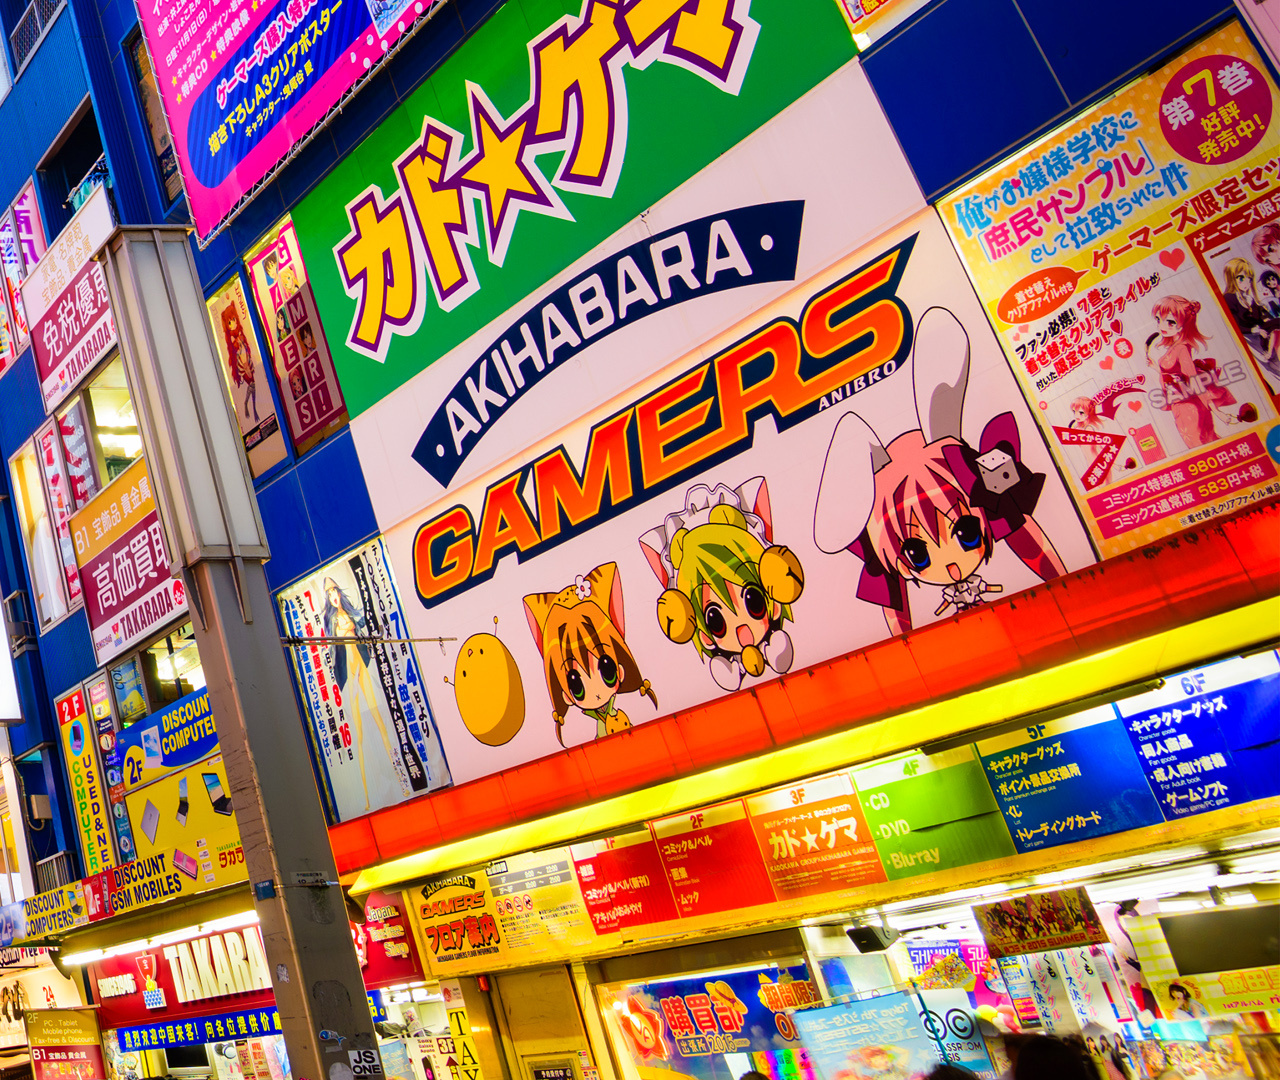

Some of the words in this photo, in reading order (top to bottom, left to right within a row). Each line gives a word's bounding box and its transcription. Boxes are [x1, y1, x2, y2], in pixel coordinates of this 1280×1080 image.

[1198, 101, 1243, 135] 好評
[817, 359, 898, 412] ANIBRO
[1149, 359, 1249, 412] SAMPLE
[412, 250, 906, 604] GAMERS
[1179, 673, 1209, 701] 6F
[126, 754, 144, 784] 2F
[900, 759, 921, 779] 4F
[788, 787, 808, 807] 3F
[689, 813, 706, 831] 2F
[113, 853, 168, 890] DISCOUNT
[24, 890, 65, 918] DISCOUNT
[110, 888, 134, 912] GSM
[133, 872, 183, 906] MOBILES
[24, 909, 74, 938] COMPUTERS
[65, 1027, 82, 1035] phone
[68, 1035, 94, 1043] Discount
[352, 1063, 382, 1074] ONE
[353, 1051, 377, 1064] JS
